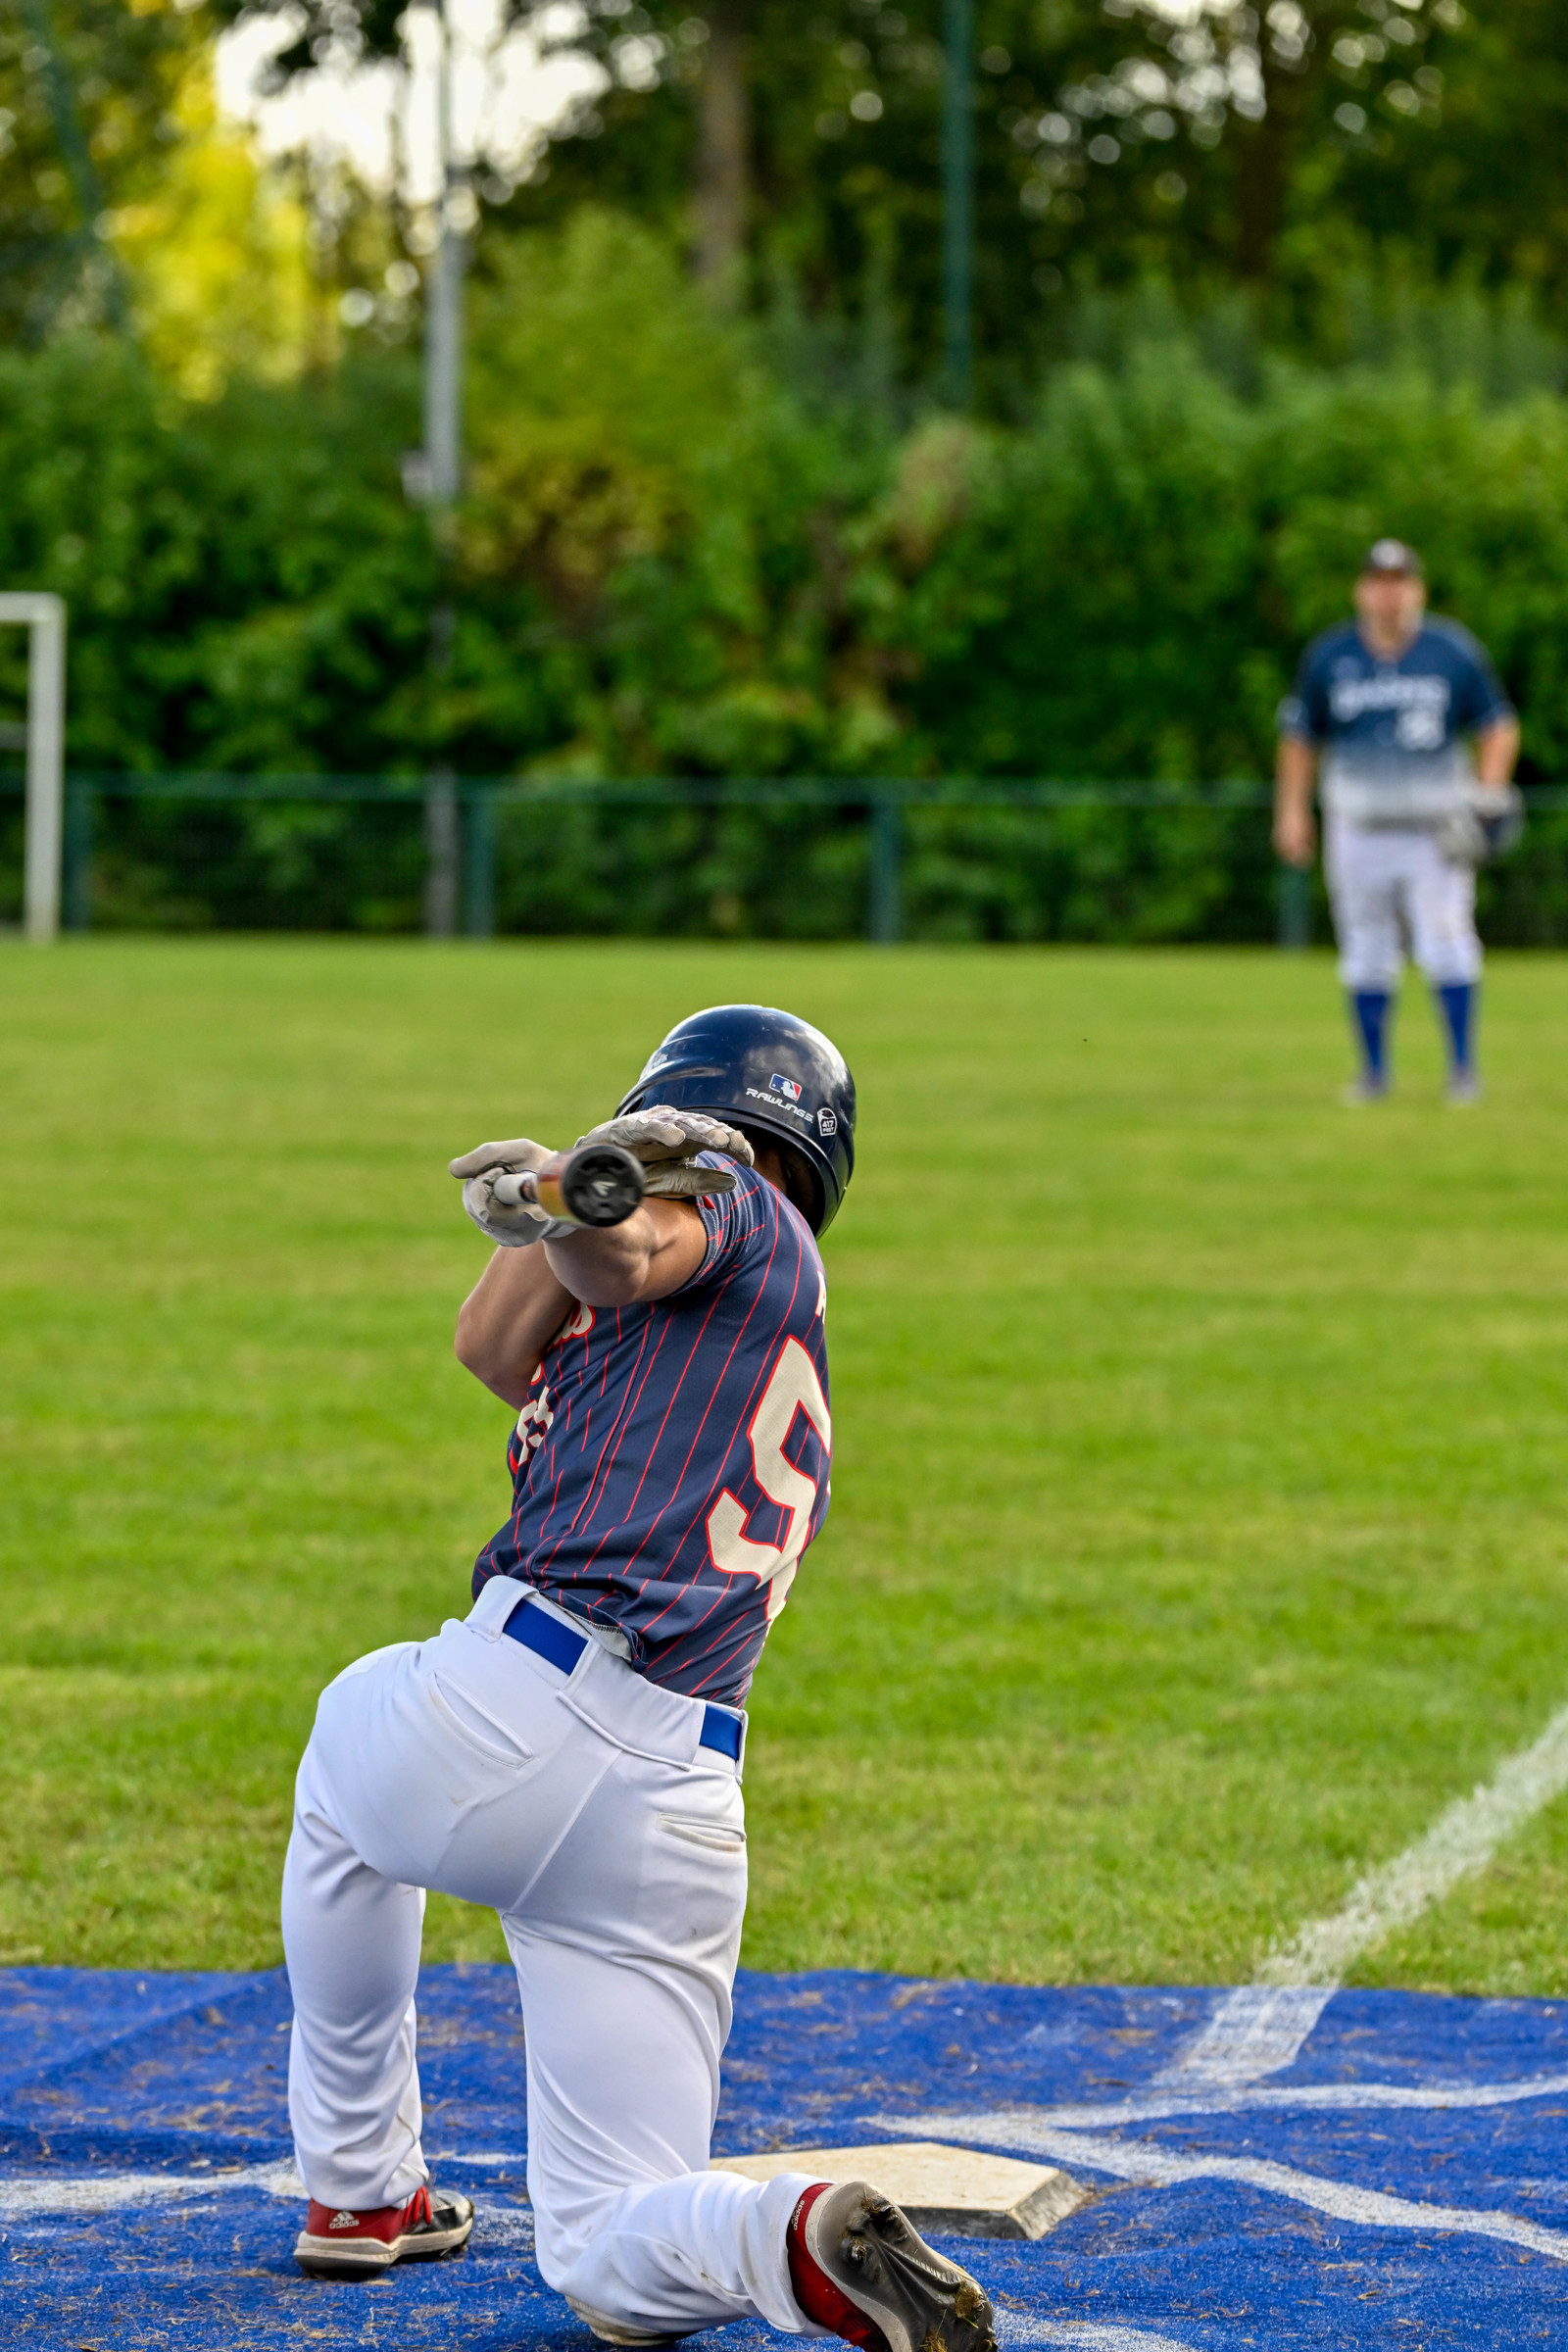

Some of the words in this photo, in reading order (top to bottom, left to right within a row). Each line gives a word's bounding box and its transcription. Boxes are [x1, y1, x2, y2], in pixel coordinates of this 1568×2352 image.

[746, 1088, 814, 1122] RAWLINGS
[328, 2218, 361, 2230] adidas
[791, 2199, 806, 2230] adidas
